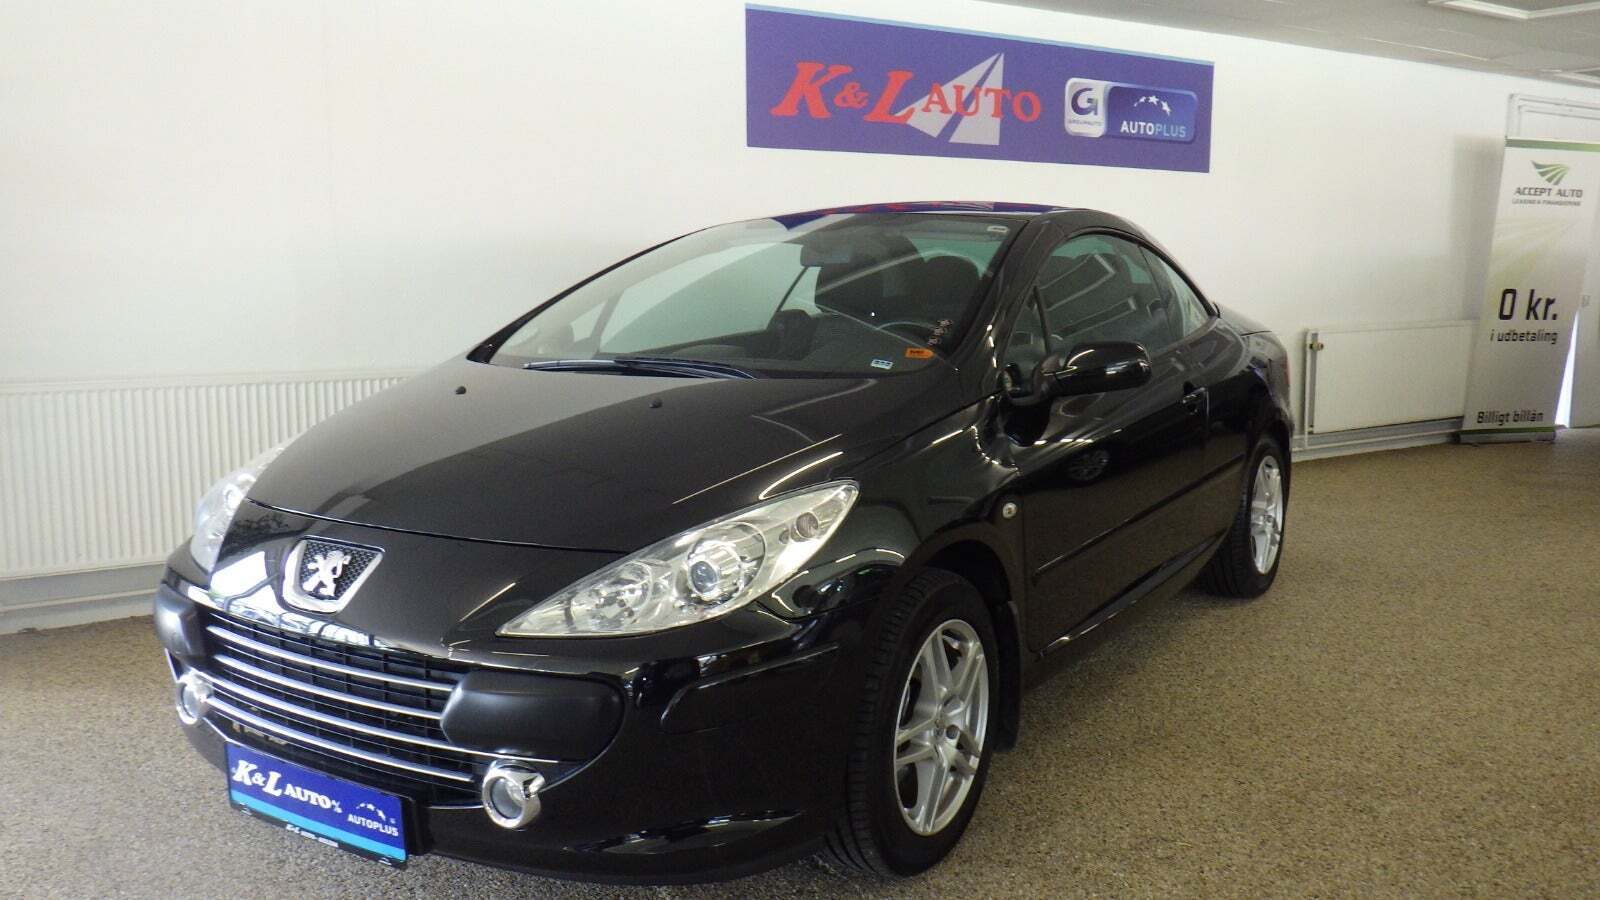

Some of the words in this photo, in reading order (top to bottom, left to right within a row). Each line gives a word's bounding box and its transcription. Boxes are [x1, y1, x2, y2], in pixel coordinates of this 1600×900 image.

[769, 61, 915, 124] K&L
[921, 82, 1042, 123] AUTO
[1120, 120, 1187, 138] AUTOPLUS
[1513, 187, 1553, 197] ACCEPT
[1556, 188, 1583, 198] AUTO
[1499, 288, 1517, 321] 0
[1526, 288, 1558, 321] kr.
[1489, 328, 1495, 342] i
[1497, 328, 1559, 345] udbetaling
[1477, 410, 1510, 426] Billigt
[232, 760, 282, 797] K&L
[284, 783, 331, 809] AUTO
[347, 813, 399, 837] AUTOPLUS
